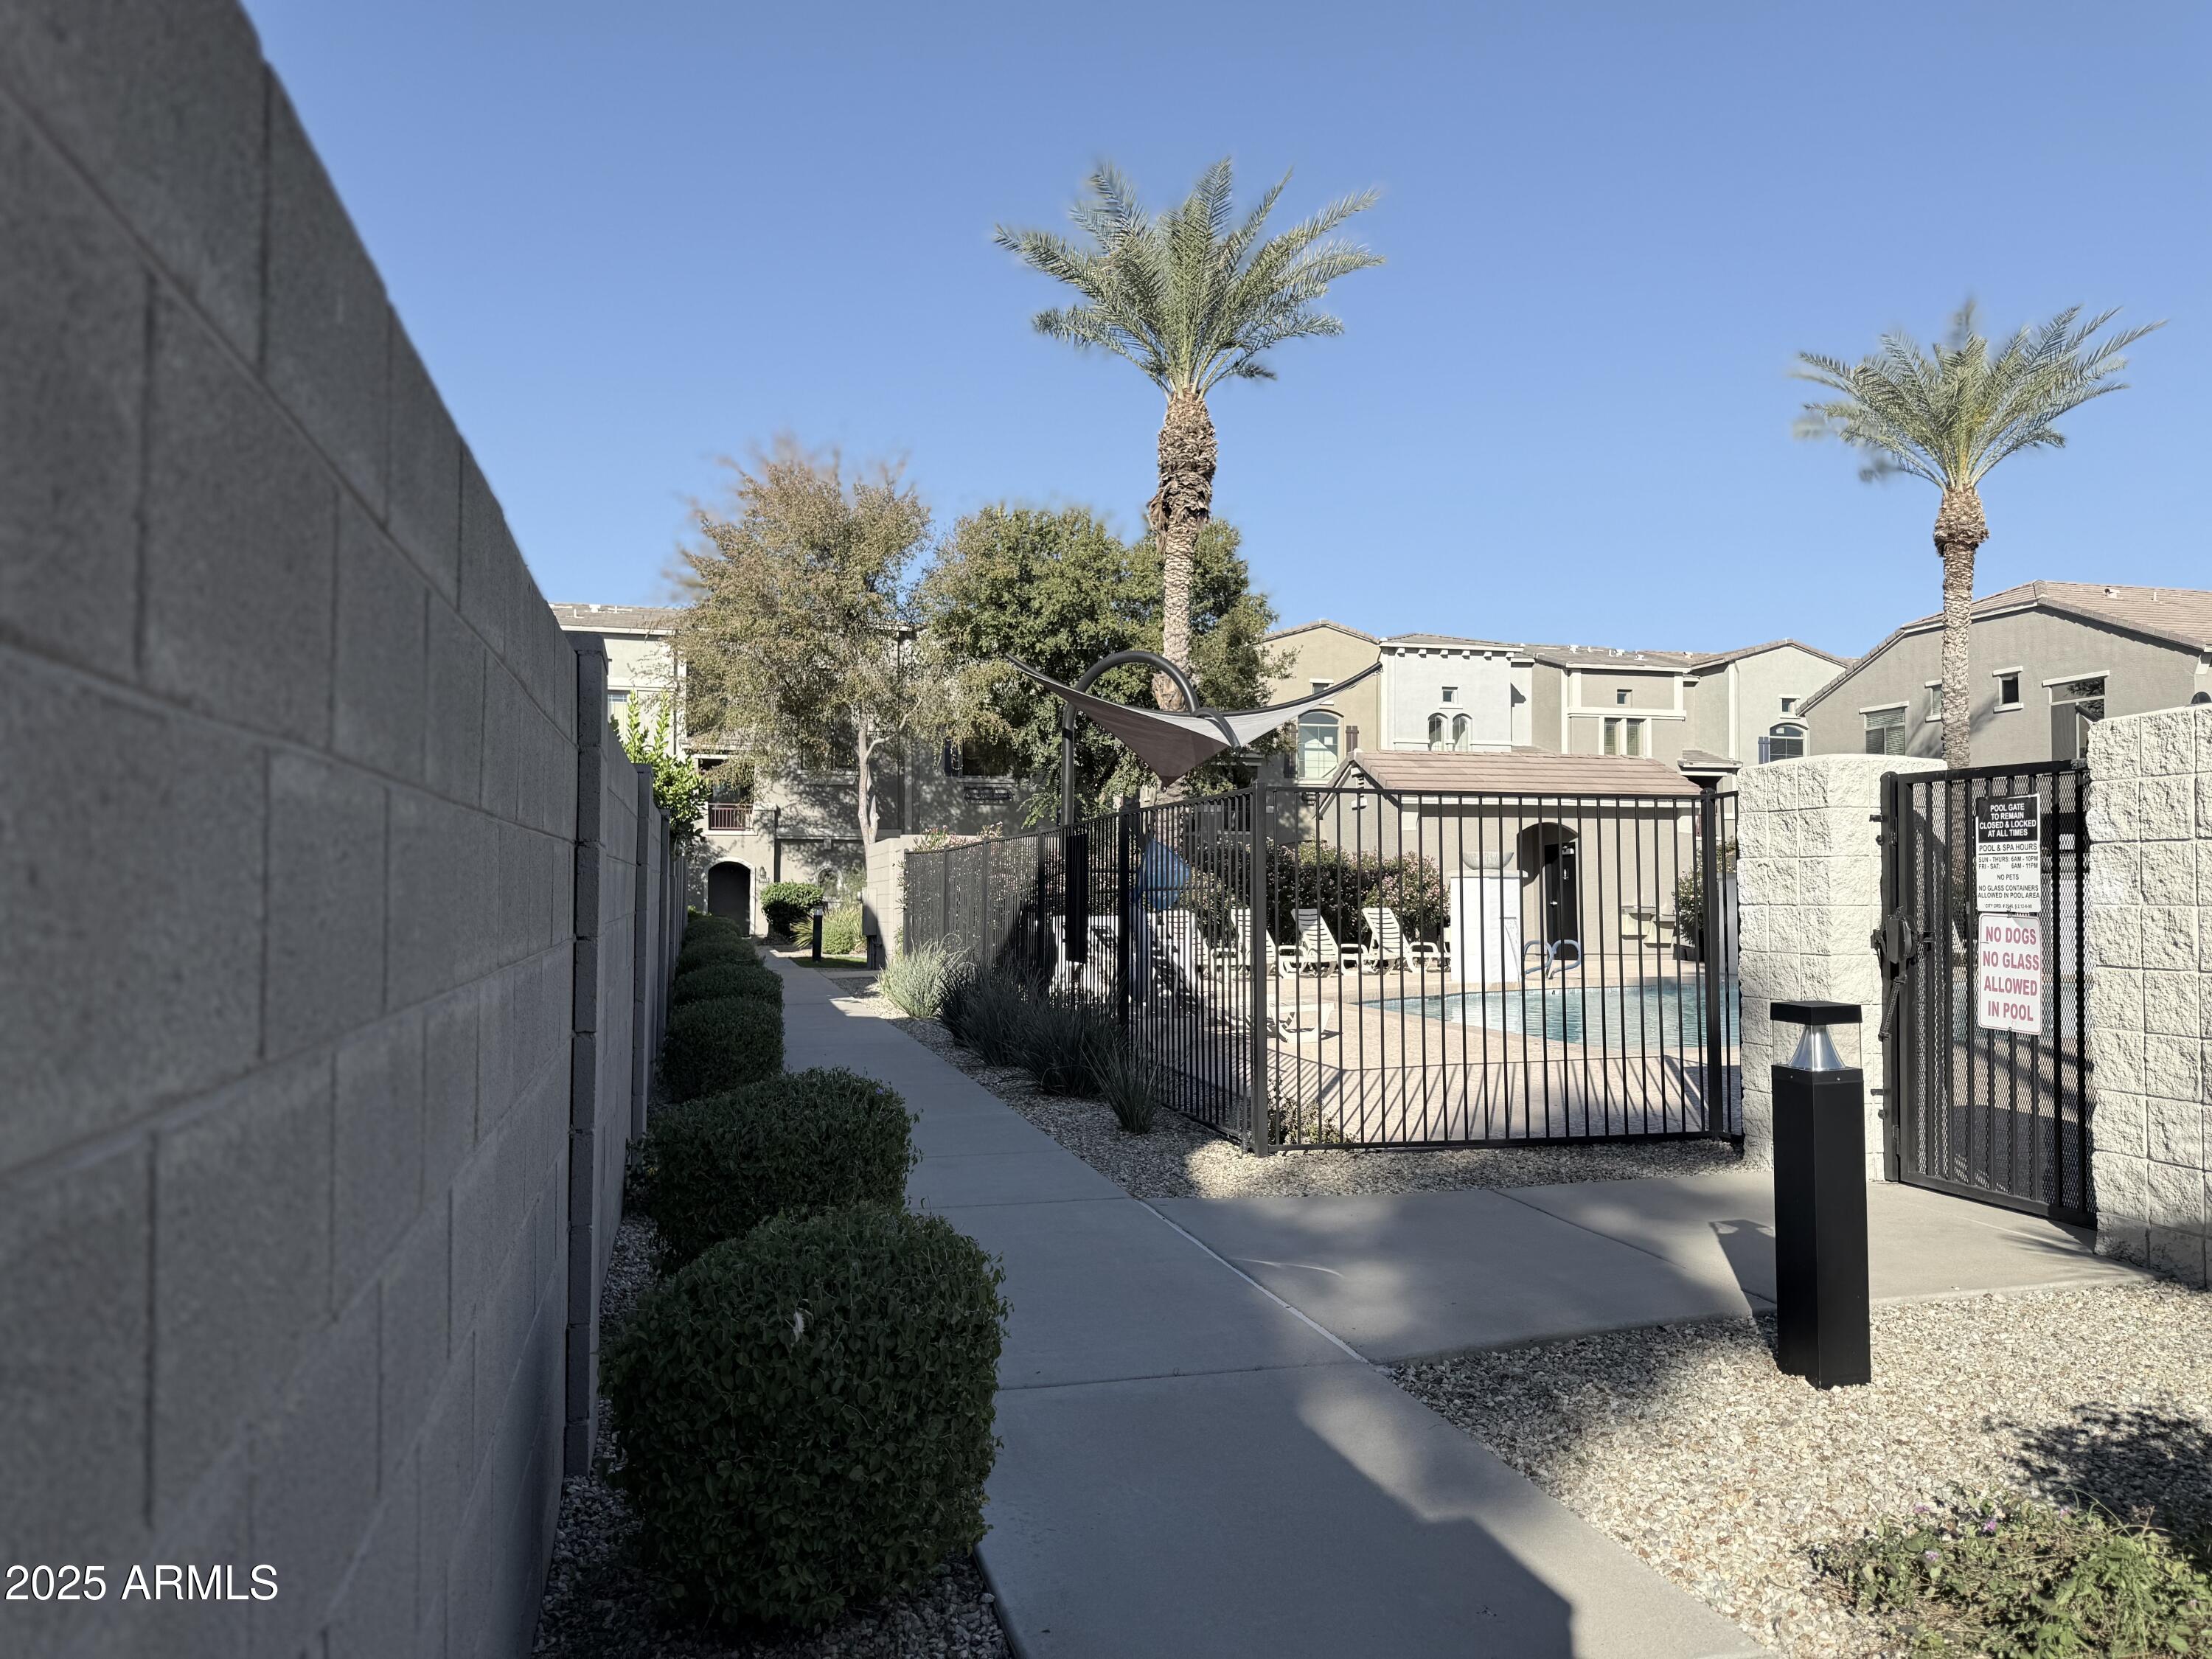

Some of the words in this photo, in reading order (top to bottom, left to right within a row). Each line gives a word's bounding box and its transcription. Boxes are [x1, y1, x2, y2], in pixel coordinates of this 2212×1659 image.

[2008, 803, 2025, 811] GATE
[2000, 812, 2024, 820] REMAIN
[1979, 821, 2004, 830] CLOSED
[2011, 819, 2037, 828] LOCKED
[1987, 830, 1995, 838] AT
[2009, 828, 2028, 836] TIMES
[1986, 926, 2002, 942] NO
[2006, 928, 2037, 945] DOGS
[1983, 950, 1999, 967] NO
[2003, 952, 2039, 971] GLASS
[1983, 975, 2038, 996] ALLOWED
[1988, 1001, 2000, 1017] IN
[2003, 1003, 2034, 1022] POOL
